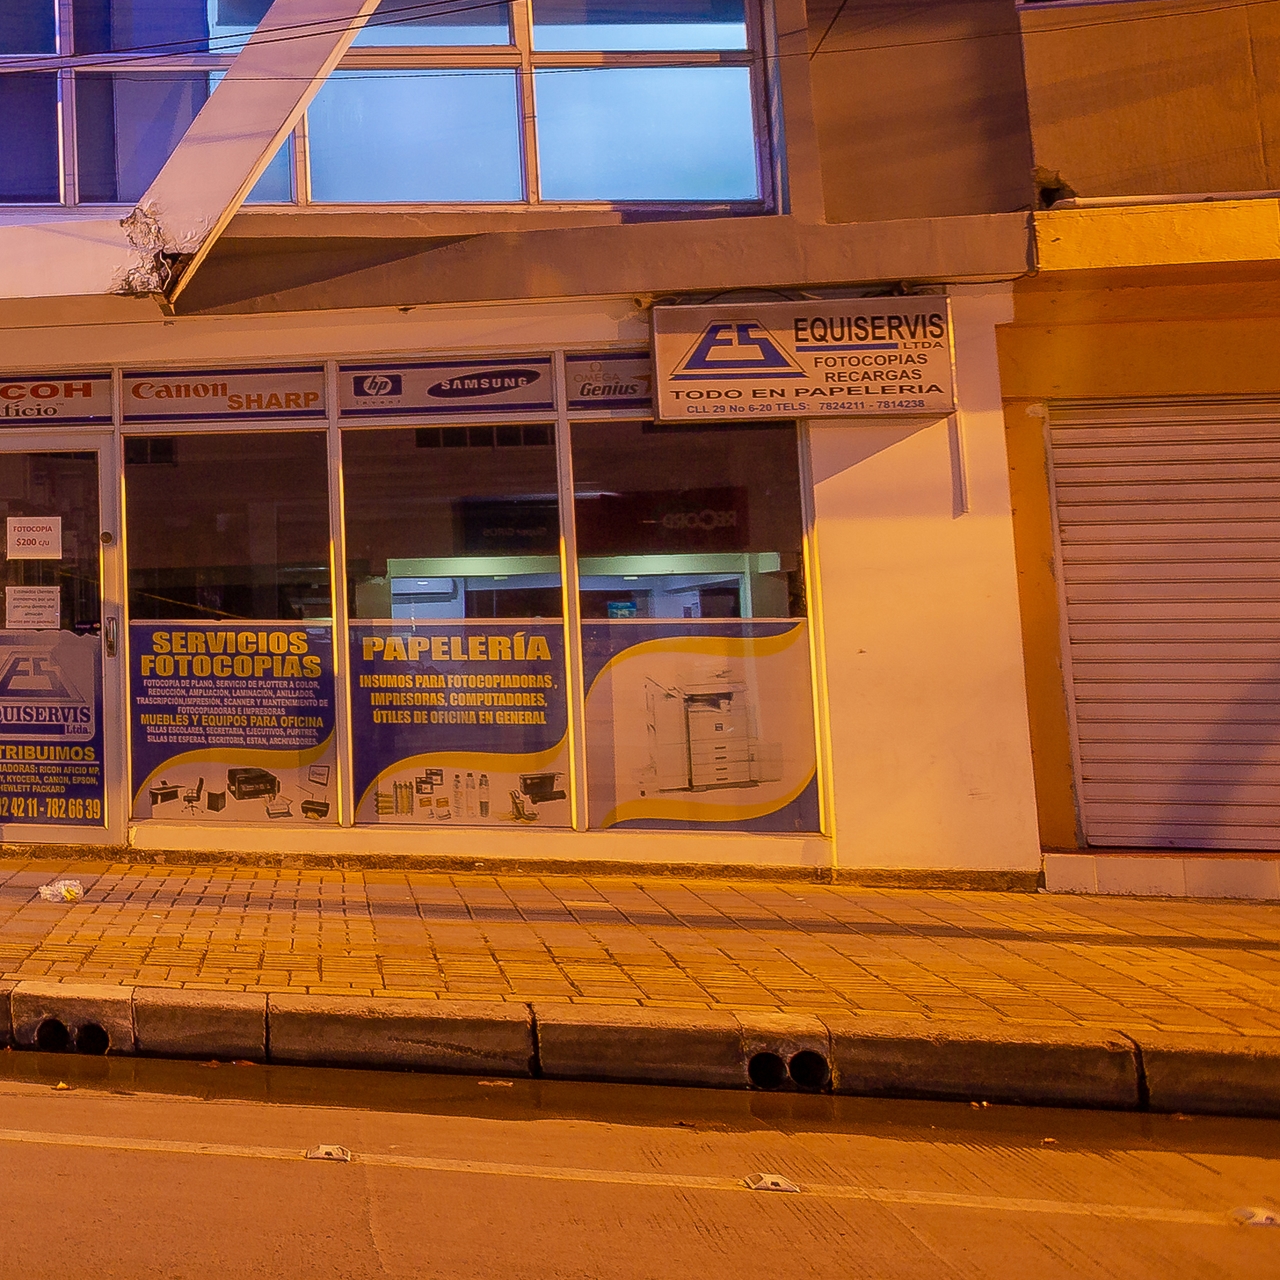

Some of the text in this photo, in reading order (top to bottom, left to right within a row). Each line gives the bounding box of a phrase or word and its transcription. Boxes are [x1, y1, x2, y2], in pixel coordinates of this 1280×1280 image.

[794, 313, 945, 343] EQUISERVIS
[903, 342, 944, 350] LTDA
[814, 354, 928, 368] FOTOCOPIAS
[441, 376, 529, 390] SAMSUNG
[574, 373, 621, 384] OMEGA
[825, 370, 922, 383] RECARGAS
[132, 380, 228, 400] Canon
[366, 376, 390, 396] hp
[579, 381, 639, 398] Genius
[670, 384, 944, 400] TODO EN PAPELERIA
[227, 391, 320, 411] SHARP
[687, 400, 925, 413] CLL 29 No 6-20 TELS: 7824211 7814238
[16, 538, 36, 546] $200
[152, 631, 309, 654] SERVICIOS
[362, 631, 552, 661] PAPELERÍA
[141, 655, 322, 678] FOTOCOPIAS
[143, 679, 180, 687] FOTOCOPIA
[191, 680, 215, 688] PLANO,
[216, 680, 246, 688] SERVICIO
[248, 680, 257, 688] DE
[258, 680, 288, 688] PLOTTER
[295, 681, 320, 689] COLOR,
[360, 674, 413, 688] INSUMOS
[415, 674, 446, 688] PARA
[148, 688, 188, 696] REDUCCIÓN,
[276, 690, 315, 698] ANILLADOS,
[371, 692, 548, 707] IMPRESORAS, COMPUTADORES,
[224, 698, 255, 706] SCANNER
[256, 698, 261, 706] Y
[262, 699, 318, 707] MANTENIMIENTO
[319, 699, 328, 707] DE
[141, 714, 324, 727] MUEBLES Y EQUIPOS PARA OFICINA
[373, 708, 547, 725] ÚTILES DE OFICINA EN GENERAL
[66, 724, 91, 735] Ltda.
[146, 726, 167, 734] SILLAS
[168, 726, 205, 734] ESCOLARES,
[246, 727, 285, 736] EJECUTIVOS,
[286, 728, 318, 736] PUPITRES,
[147, 735, 168, 743] SILLAS
[169, 735, 177, 743] DE
[178, 736, 206, 744] ESPERAS,
[63, 766, 86, 774] AFICIO
[7, 775, 42, 784] KYOCERA,
[44, 776, 70, 785] CANON,
[72, 777, 98, 785] EPSON,
[32, 785, 66, 793] PACKARD
[10, 798, 25, 817] 42
[26, 798, 38, 817] 11
[46, 798, 66, 818] 782
[68, 799, 84, 818] 66
[86, 799, 101, 819] 39
